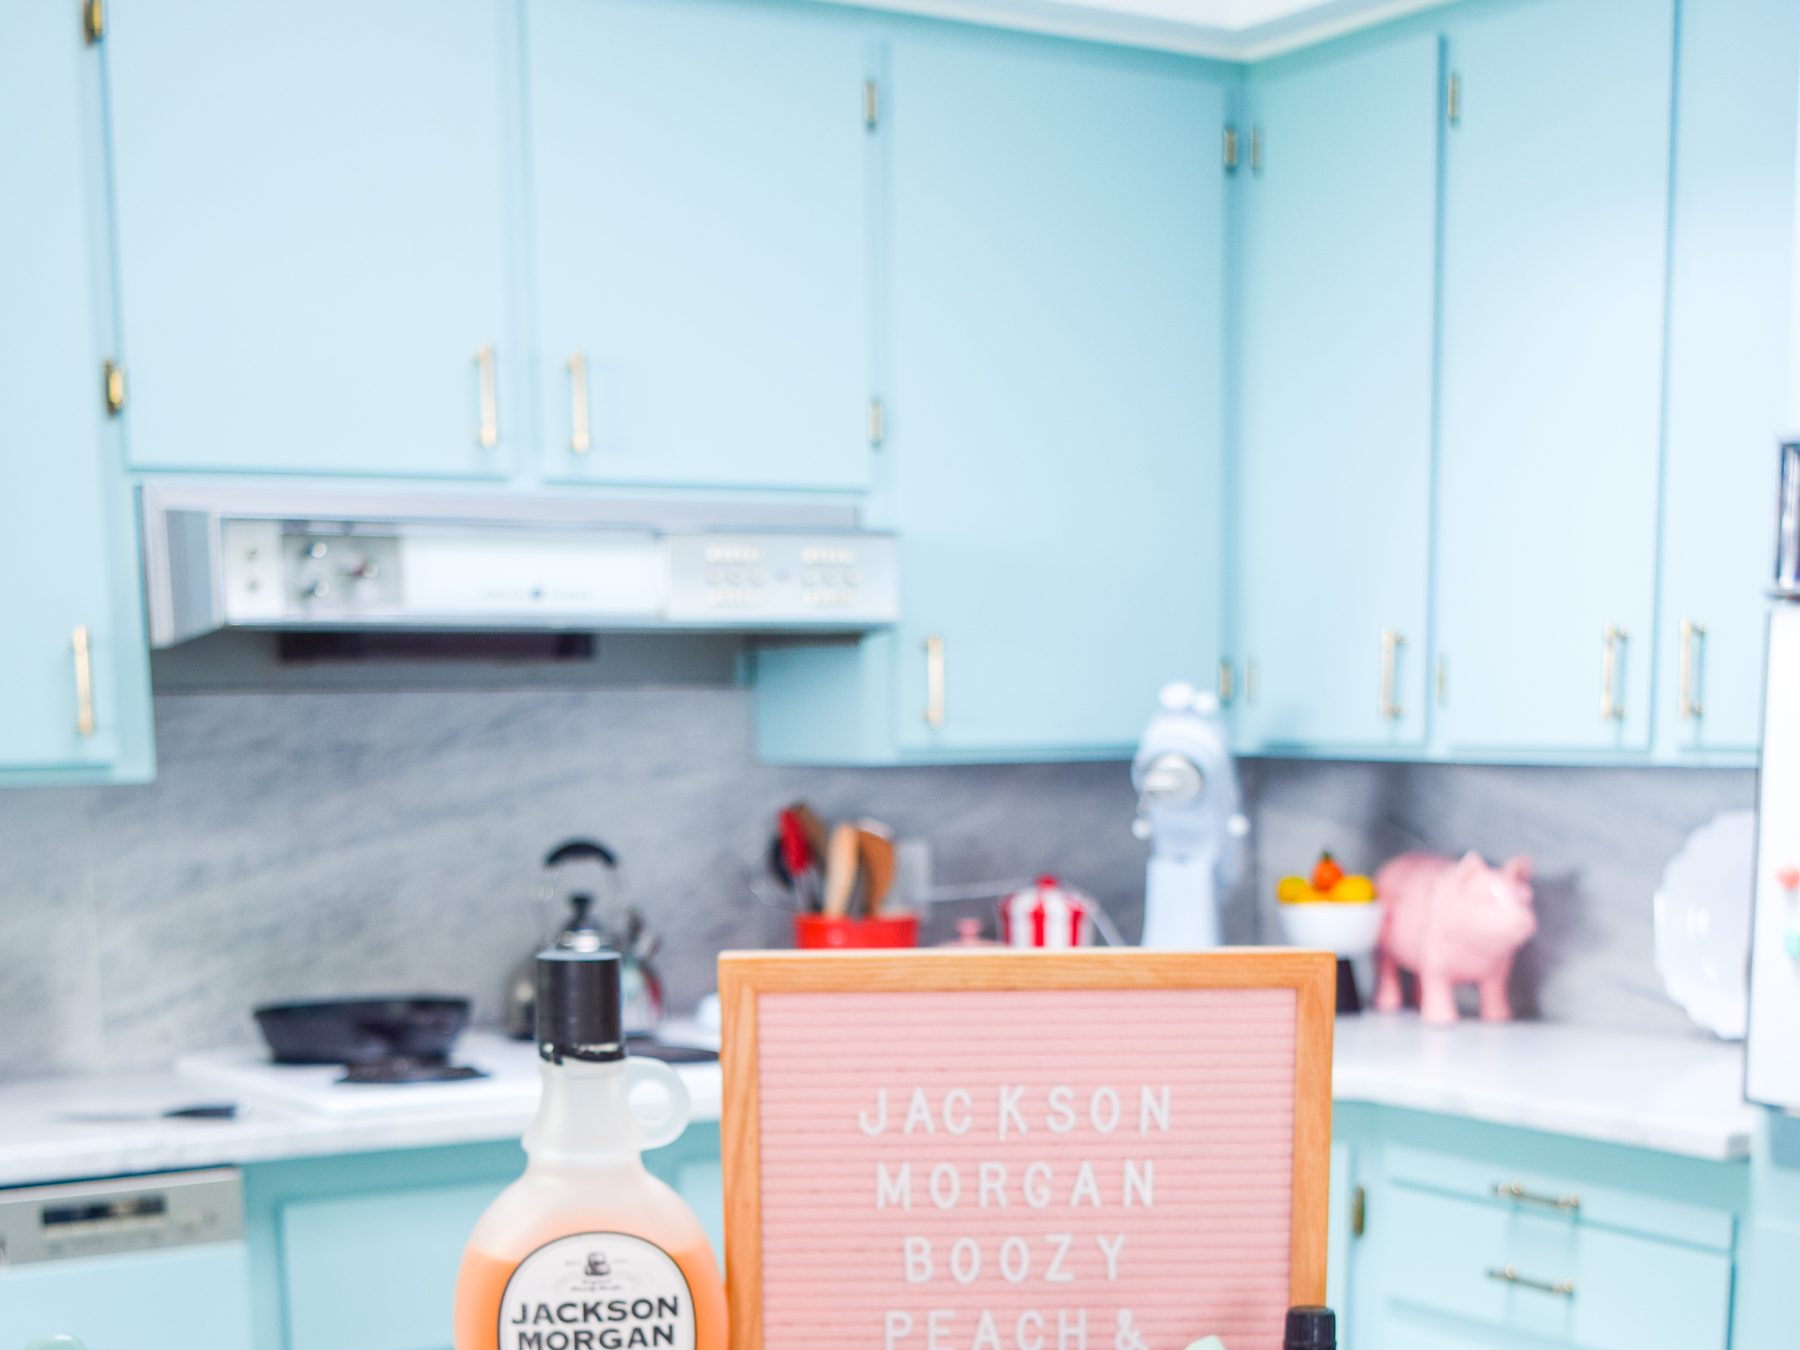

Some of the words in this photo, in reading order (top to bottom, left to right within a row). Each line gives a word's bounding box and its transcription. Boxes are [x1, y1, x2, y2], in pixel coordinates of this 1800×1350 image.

[858, 1084, 1171, 1138] JACKSON
[876, 1159, 1154, 1211] MORGAN
[903, 1233, 1127, 1285] BOOZY
[511, 1296, 679, 1325] JACKSON
